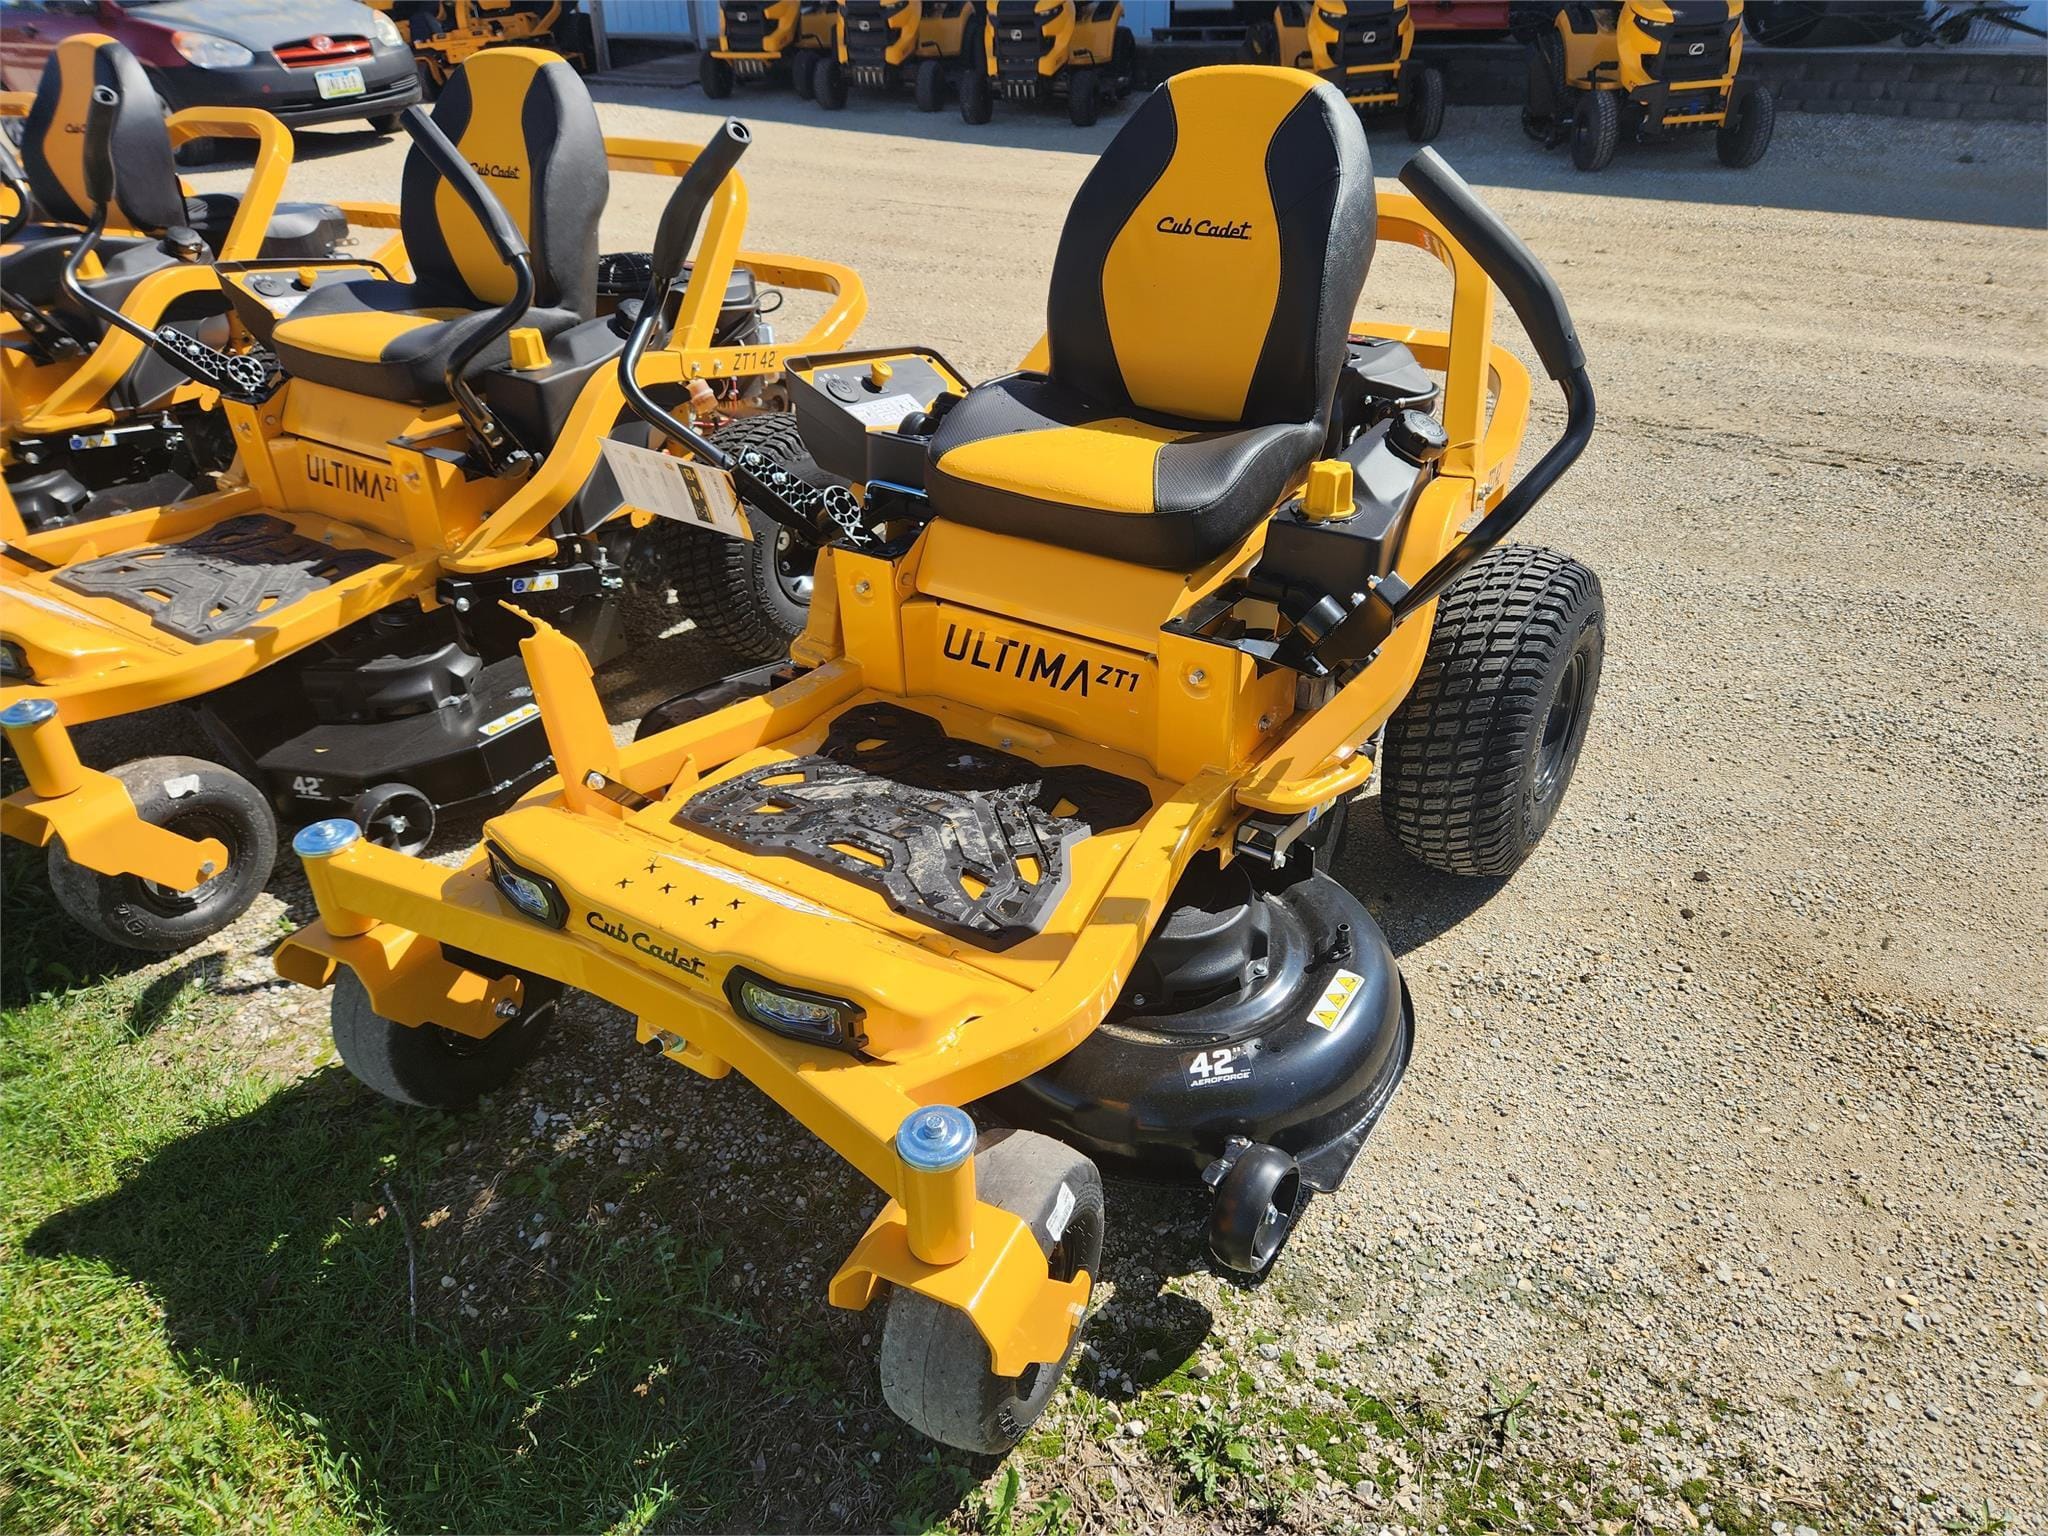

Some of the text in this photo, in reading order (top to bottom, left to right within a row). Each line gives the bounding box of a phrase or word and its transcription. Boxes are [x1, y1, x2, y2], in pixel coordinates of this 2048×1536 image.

[490, 165, 521, 180] Cadet
[1156, 216, 1252, 240] Cub Cadet
[306, 453, 385, 502] ULTIMA
[943, 624, 1140, 698] ULTIMA ZT1
[586, 911, 706, 980] Cub Cadet
[1190, 1071, 1252, 1087] AEROFORCE
